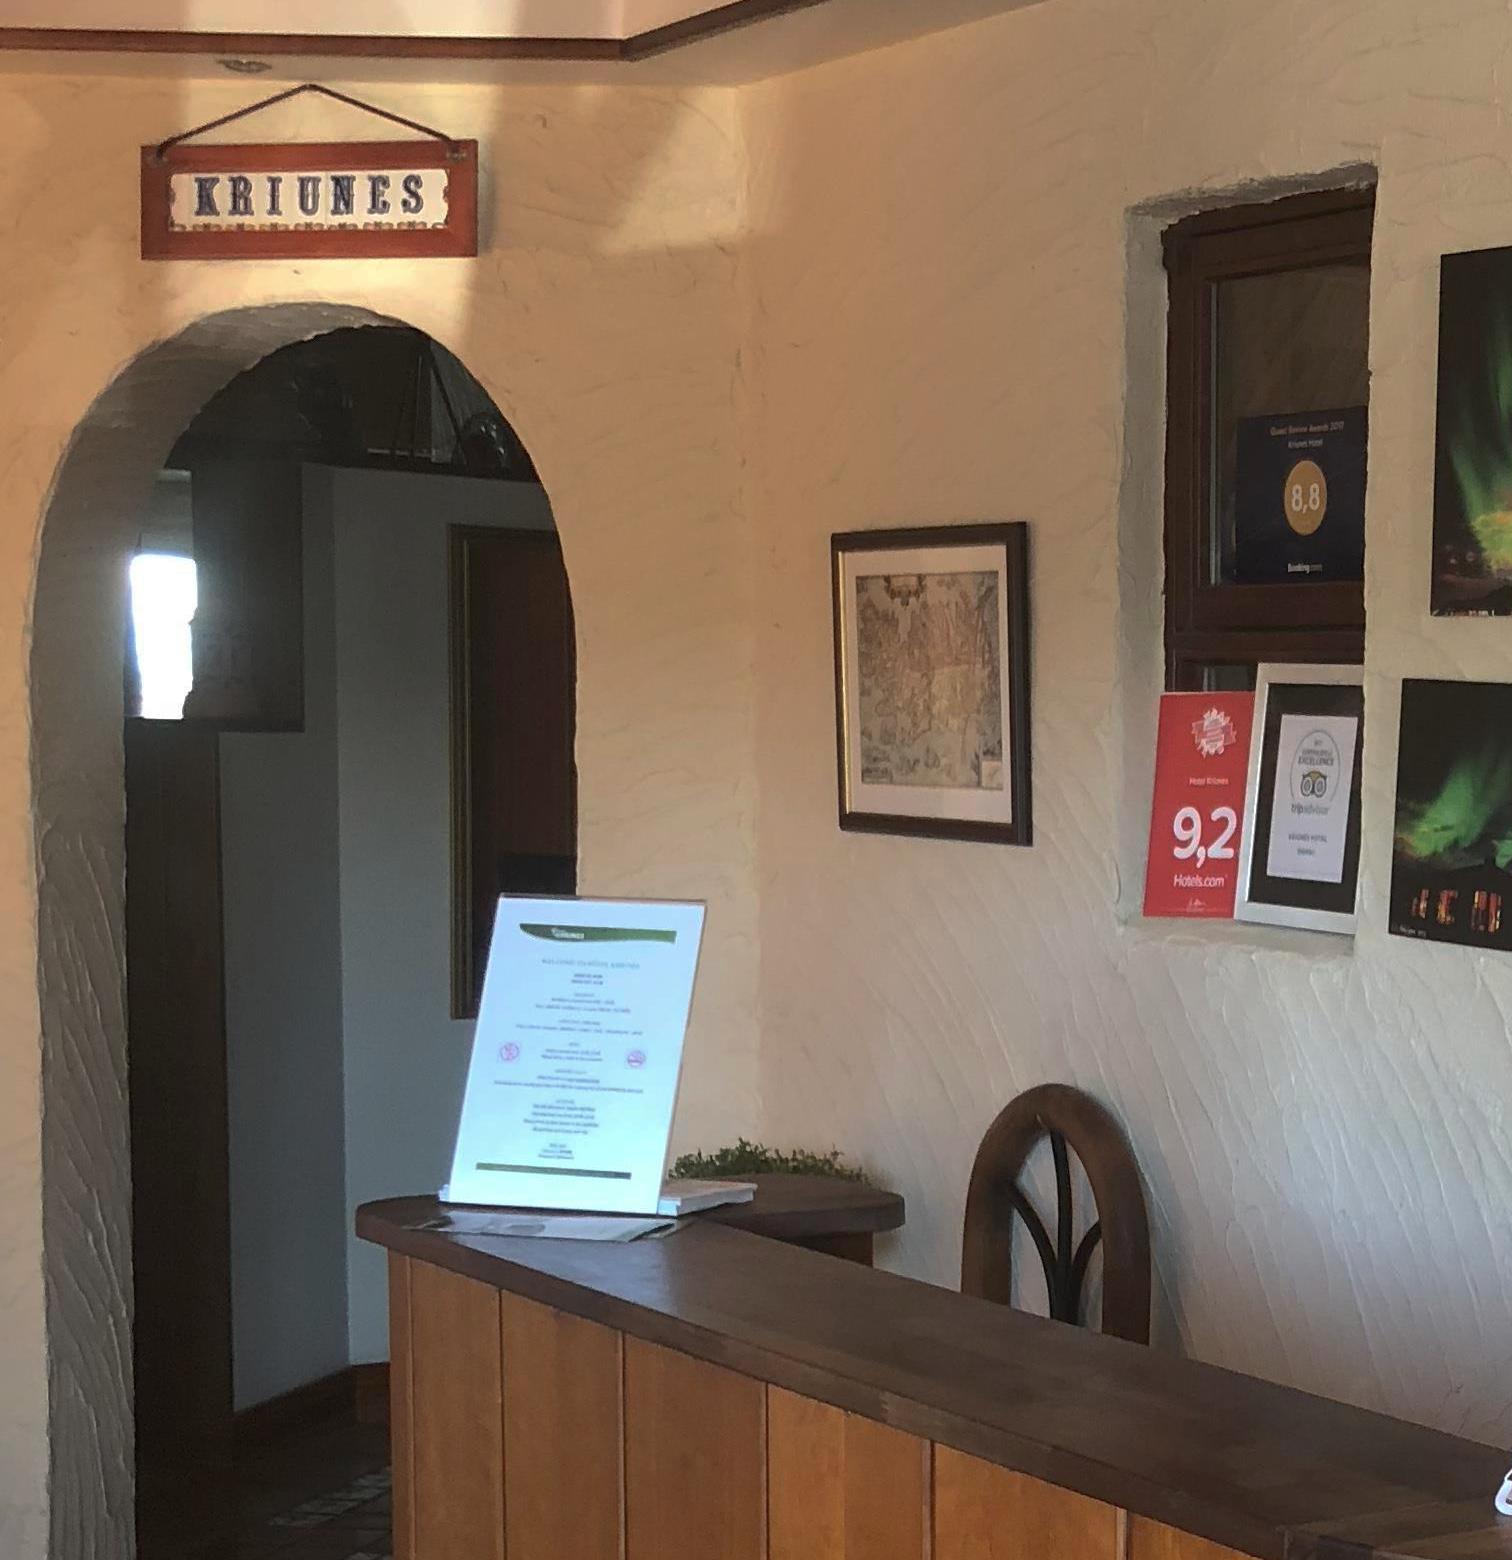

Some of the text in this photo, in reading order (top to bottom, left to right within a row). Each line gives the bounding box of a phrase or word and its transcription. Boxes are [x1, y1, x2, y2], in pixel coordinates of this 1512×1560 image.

[194, 174, 425, 216] KRIUNES
[1291, 482, 1320, 514] 8,8
[1173, 806, 1237, 869] 9,2
[1173, 874, 1225, 888] Hotels.com
